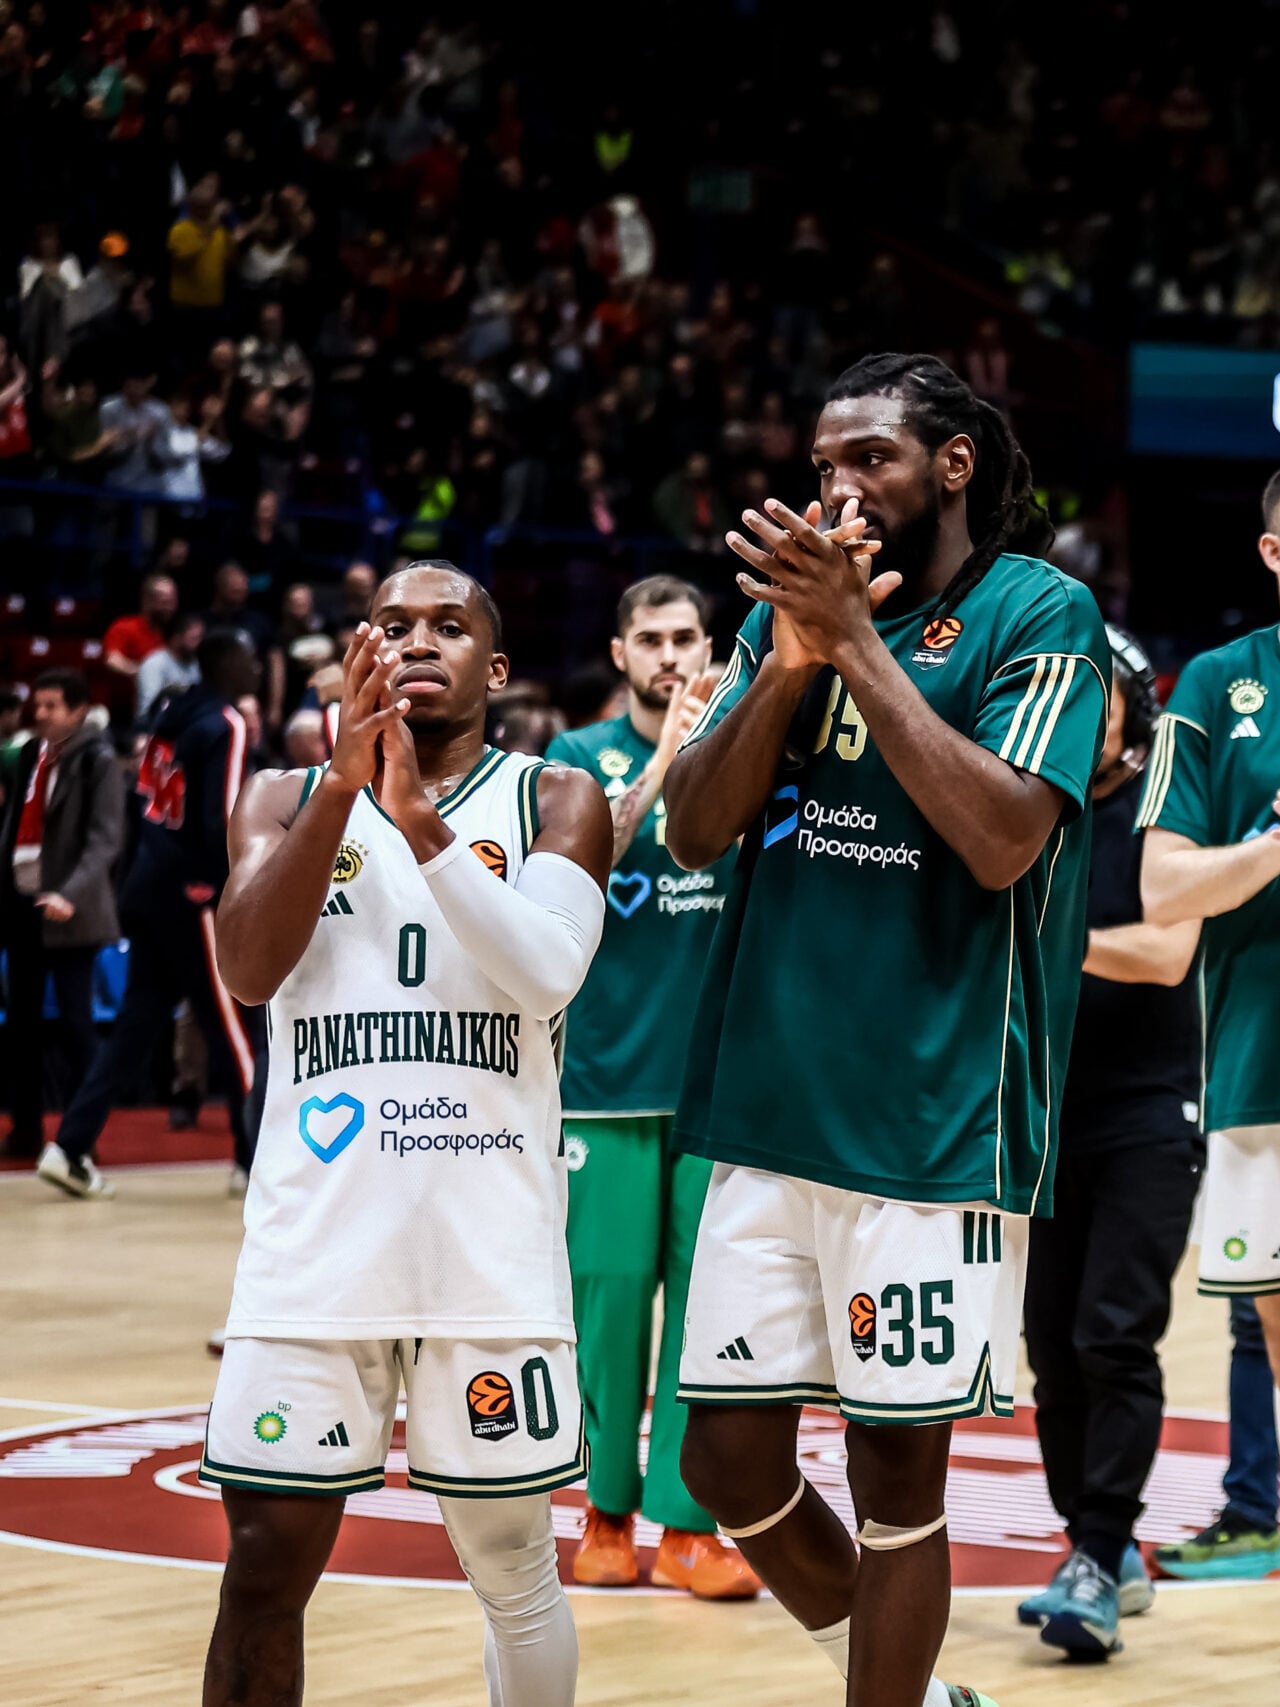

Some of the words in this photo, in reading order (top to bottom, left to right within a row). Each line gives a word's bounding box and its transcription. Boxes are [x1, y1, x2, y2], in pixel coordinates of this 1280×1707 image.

[803, 799, 877, 831] Ομάδα
[798, 829, 921, 870] Προσφοράς
[398, 923, 427, 987] 0
[293, 1011, 520, 1085] PANATHINAIKOS
[380, 1097, 468, 1126] Ομάδα
[380, 1129, 525, 1158] Προσφοράς
[880, 1280, 955, 1368] 35
[277, 1399, 292, 1413] bp
[521, 1356, 560, 1442] 0
